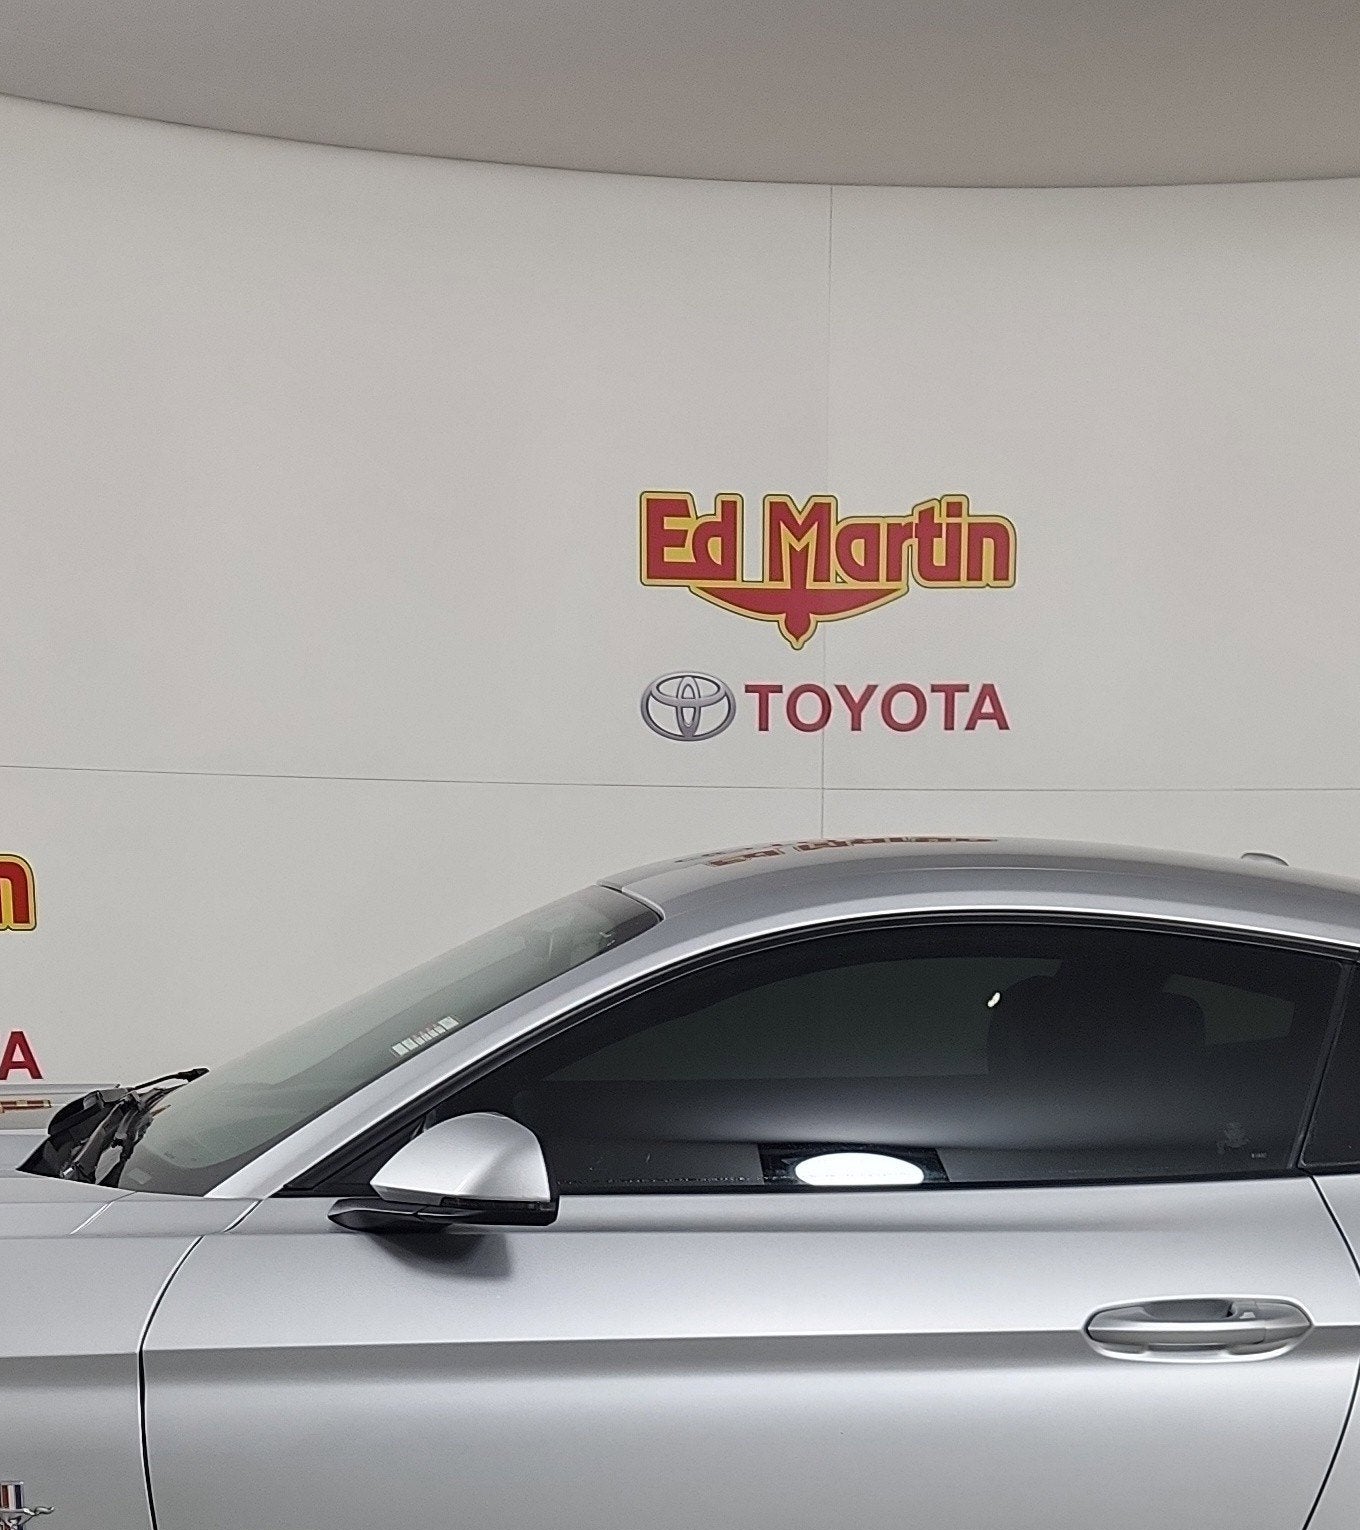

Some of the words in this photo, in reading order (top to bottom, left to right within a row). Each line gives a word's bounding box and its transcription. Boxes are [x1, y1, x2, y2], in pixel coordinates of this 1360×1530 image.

[641, 491, 743, 586] Ed
[763, 494, 1016, 588] Martin
[745, 683, 1010, 732] TOYOTA
